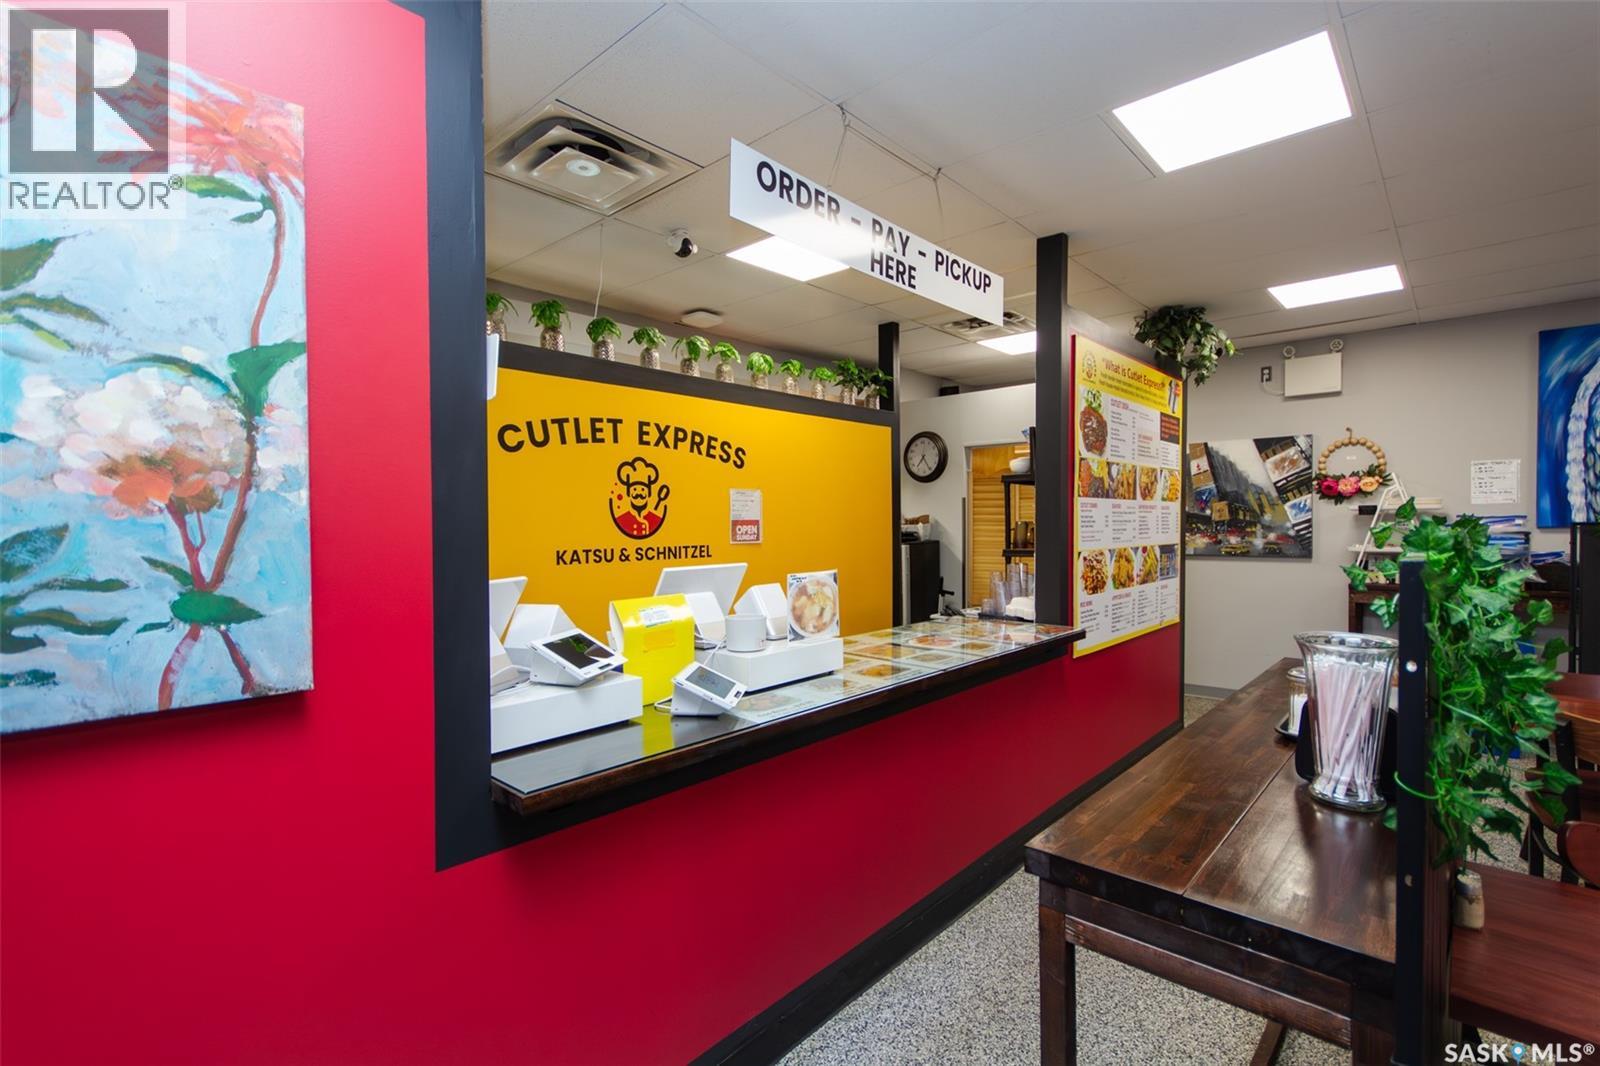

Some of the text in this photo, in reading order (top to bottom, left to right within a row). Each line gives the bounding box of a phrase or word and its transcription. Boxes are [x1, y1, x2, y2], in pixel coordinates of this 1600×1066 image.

[756, 160, 841, 226] ORDER
[872, 217, 911, 257] PAY
[935, 250, 992, 293] PICKUP
[870, 249, 917, 290] HERE
[497, 417, 747, 470] CUTLET EXPRESS
[736, 524, 758, 535] OPEN
[556, 544, 713, 566] KATSU & SCHNITZEL
